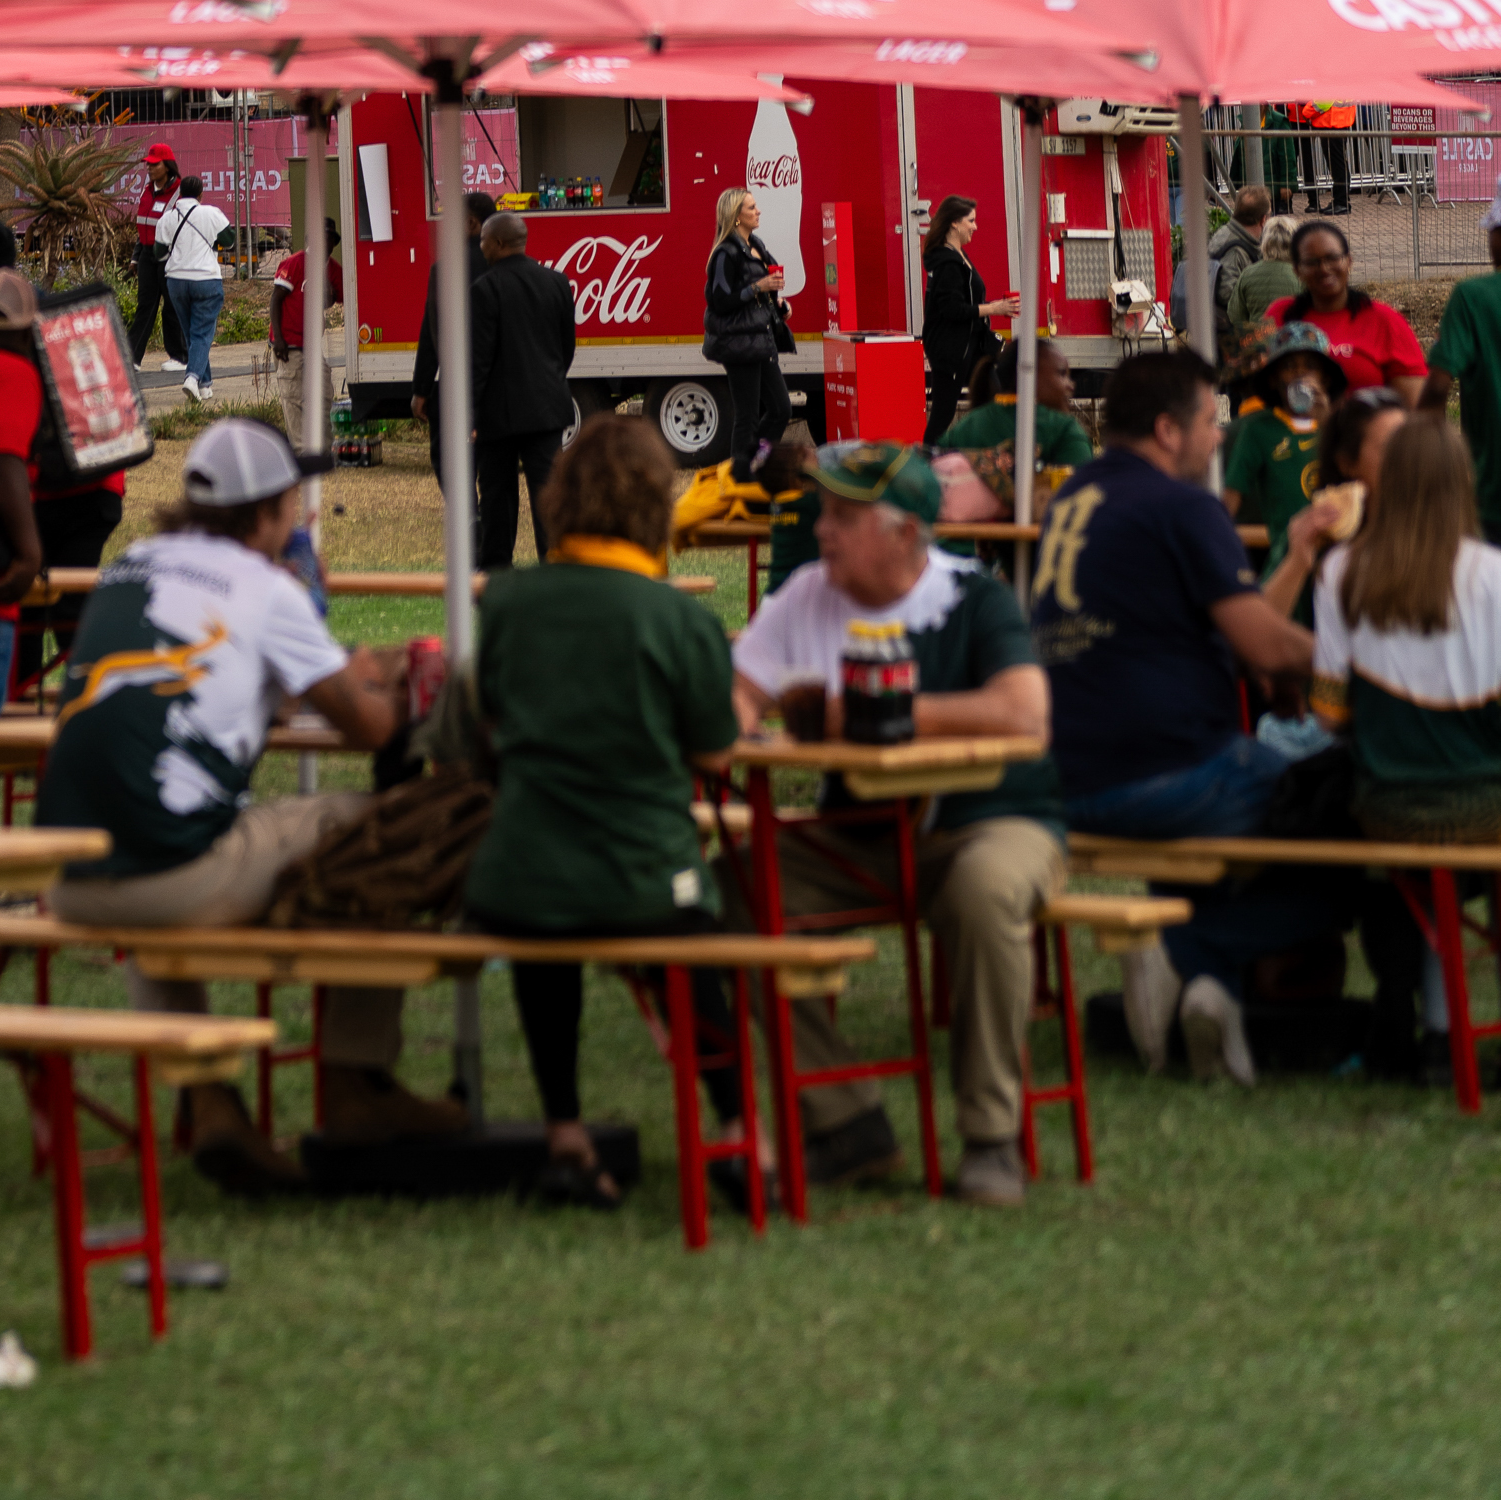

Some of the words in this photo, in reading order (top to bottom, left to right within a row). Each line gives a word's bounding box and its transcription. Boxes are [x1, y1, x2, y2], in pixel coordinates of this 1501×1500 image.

[876, 36, 968, 65] LAGER
[1393, 108, 1402, 116] NO
[1403, 108, 1421, 117] CANS
[1422, 109, 1433, 117] OR
[1393, 115, 1433, 124] BEVERAGES
[1391, 123, 1417, 131] BEYOND
[1419, 123, 1436, 131] THIS
